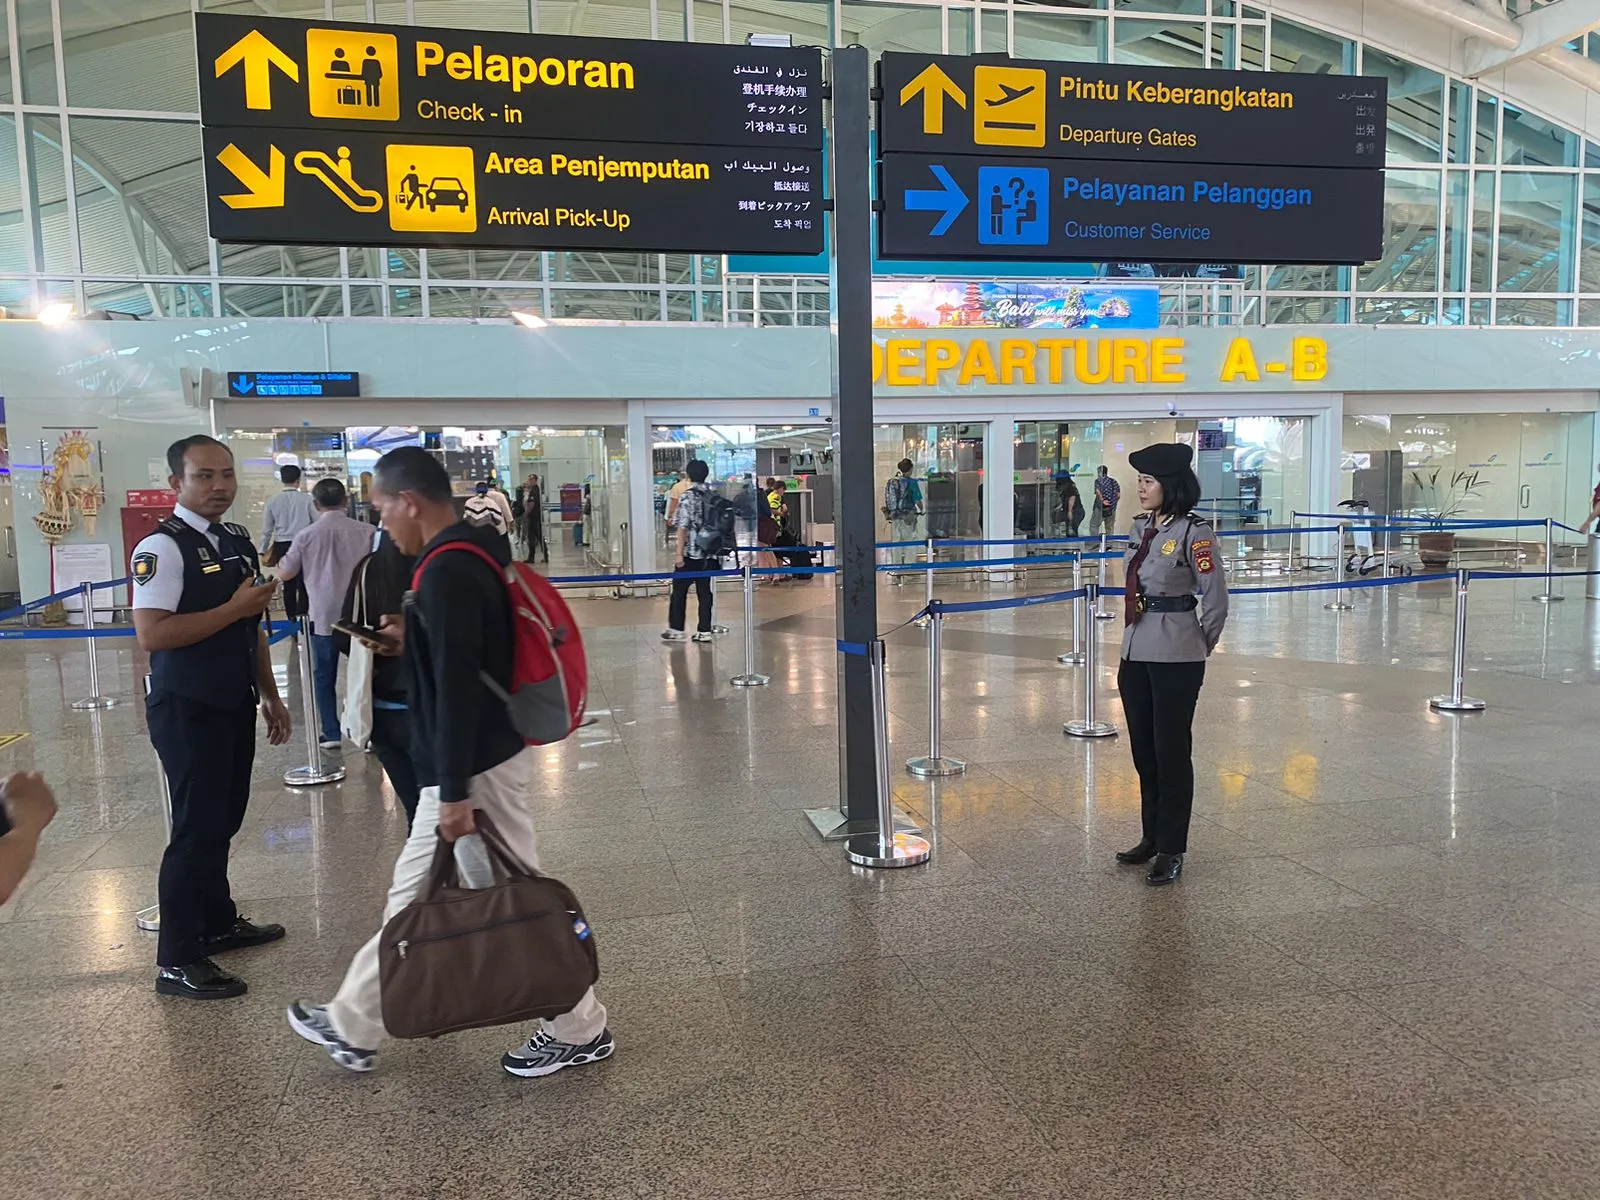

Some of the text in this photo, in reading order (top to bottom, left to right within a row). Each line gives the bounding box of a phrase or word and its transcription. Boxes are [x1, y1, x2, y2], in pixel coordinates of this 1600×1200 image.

[416, 41, 636, 92] Pelaporan
[733, 65, 769, 75] الفندق
[742, 83, 808, 98] 登机手续办理
[1060, 76, 1295, 112] Pintu Keberangkatan
[417, 99, 484, 122] Check
[504, 104, 523, 124] in
[746, 102, 808, 116] チェックイン
[1059, 123, 1197, 150] Departure Gates
[484, 151, 710, 184] Area Penjemputan
[1063, 177, 1312, 210] Pelayanan Pelanggan
[487, 206, 631, 232] Arrival Pick-Up
[1064, 221, 1212, 241] Customer Service
[996, 299, 1033, 317] Bali
[1035, 306, 1054, 316] will
[1057, 305, 1078, 316] miss
